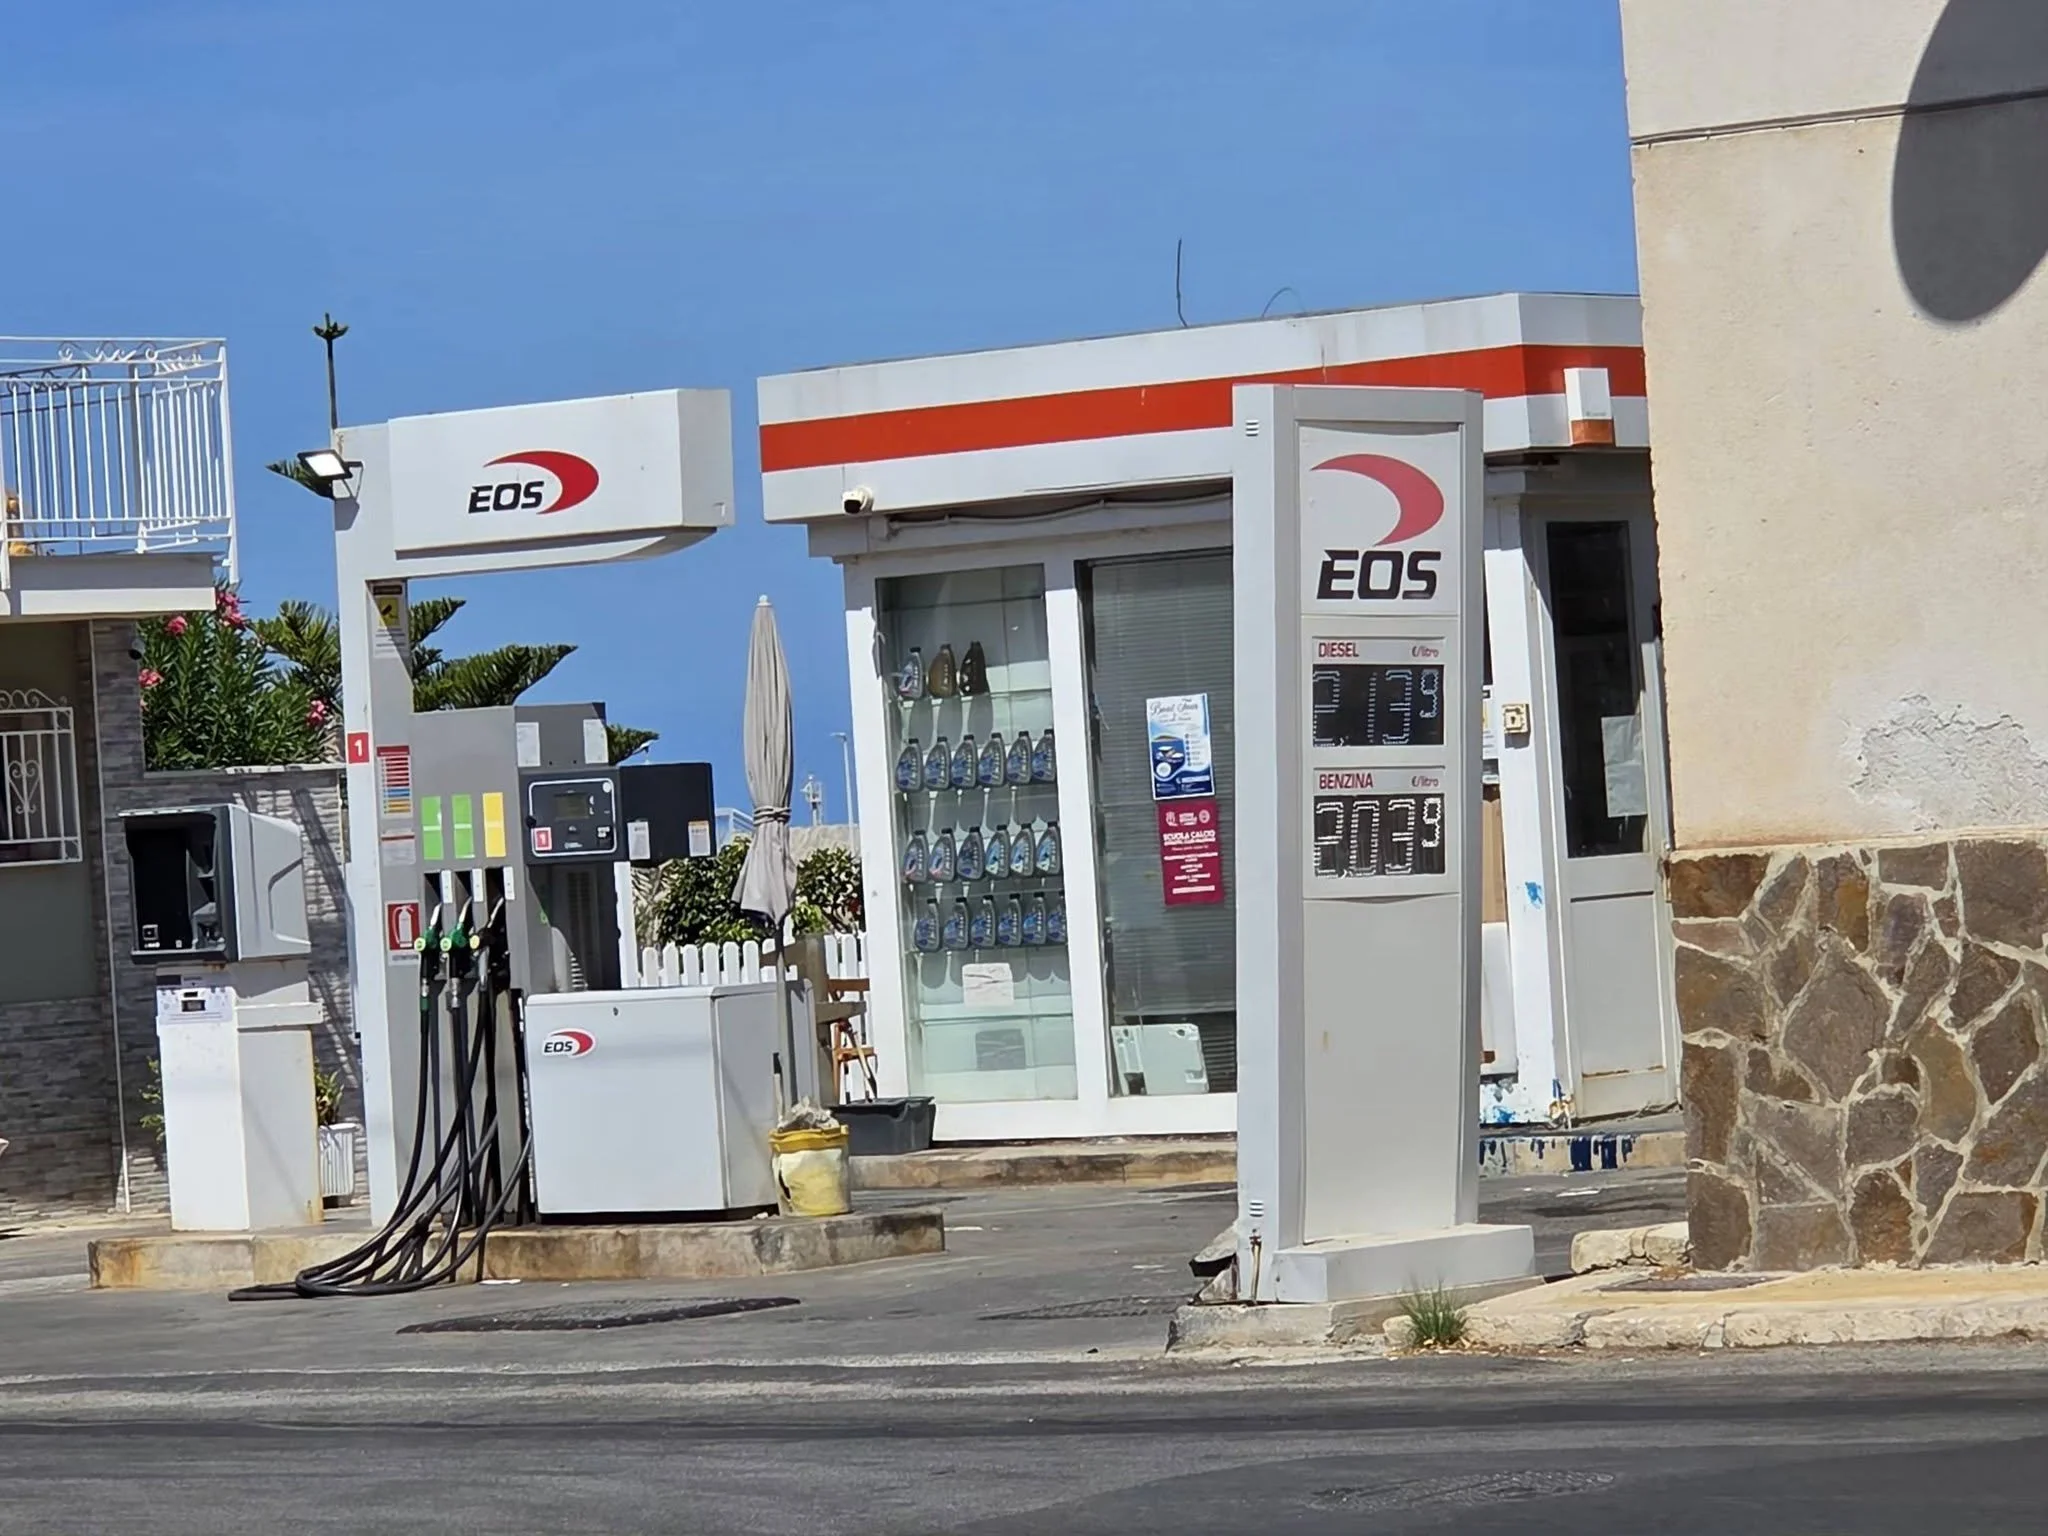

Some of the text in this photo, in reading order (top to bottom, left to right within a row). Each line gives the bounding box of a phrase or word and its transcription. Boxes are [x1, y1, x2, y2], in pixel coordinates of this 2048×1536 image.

[468, 481, 545, 514] EOS
[1316, 549, 1442, 600] EOS
[1318, 642, 1359, 657] DIESEL
[354, 739, 363, 757] 1
[1319, 773, 1373, 789] BENZINA
[1163, 832, 1190, 842] SCUOLA
[1190, 829, 1216, 839] CALCIO
[544, 1041, 573, 1053] EOS
